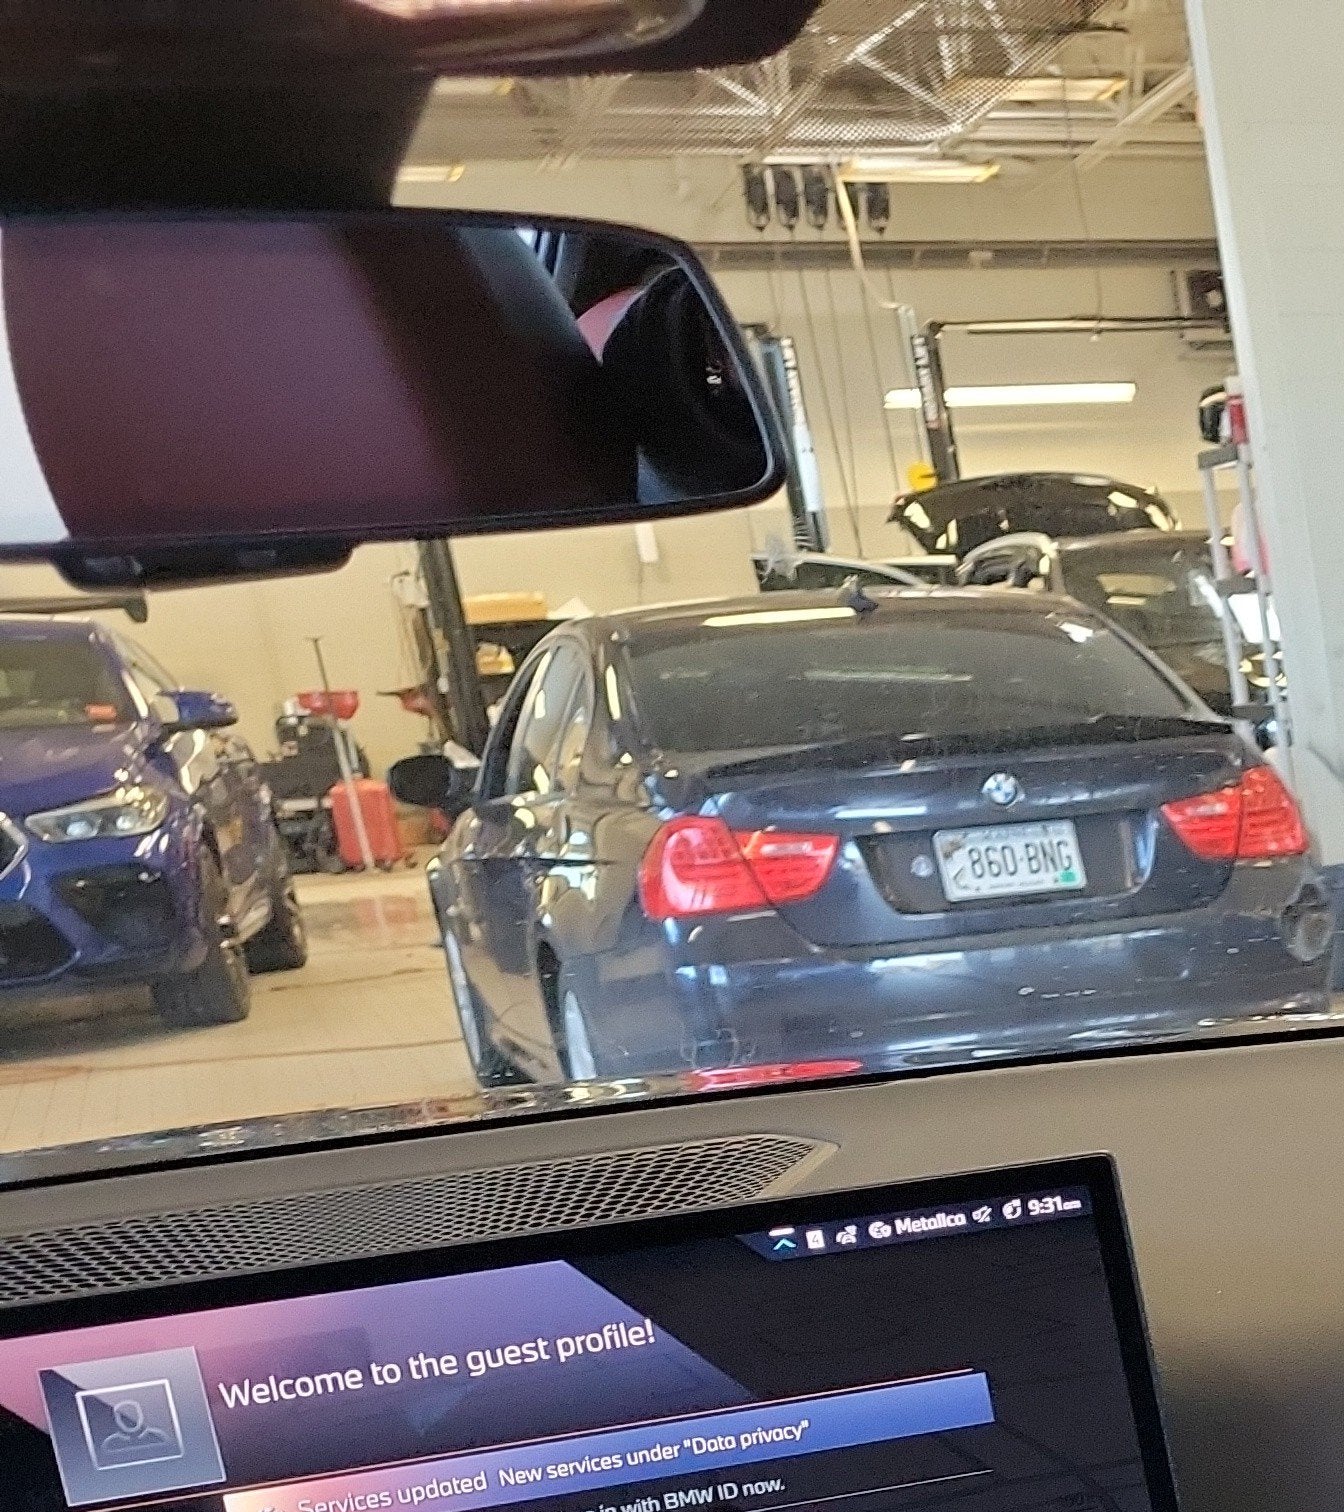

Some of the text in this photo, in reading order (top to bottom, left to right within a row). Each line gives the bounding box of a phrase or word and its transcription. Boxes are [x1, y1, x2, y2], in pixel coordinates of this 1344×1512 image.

[218, 1318, 656, 1409] Welcome to the guest profile!
[397, 1470, 488, 1506] updated
[499, 1465, 543, 1487] New
[547, 1454, 623, 1479] services
[626, 1442, 681, 1466] under
[683, 1434, 736, 1456] "Data
[740, 1420, 810, 1450] privacy"
[663, 1485, 715, 1510] BMW
[717, 1482, 738, 1500] ID
[742, 1478, 786, 1497] now.
